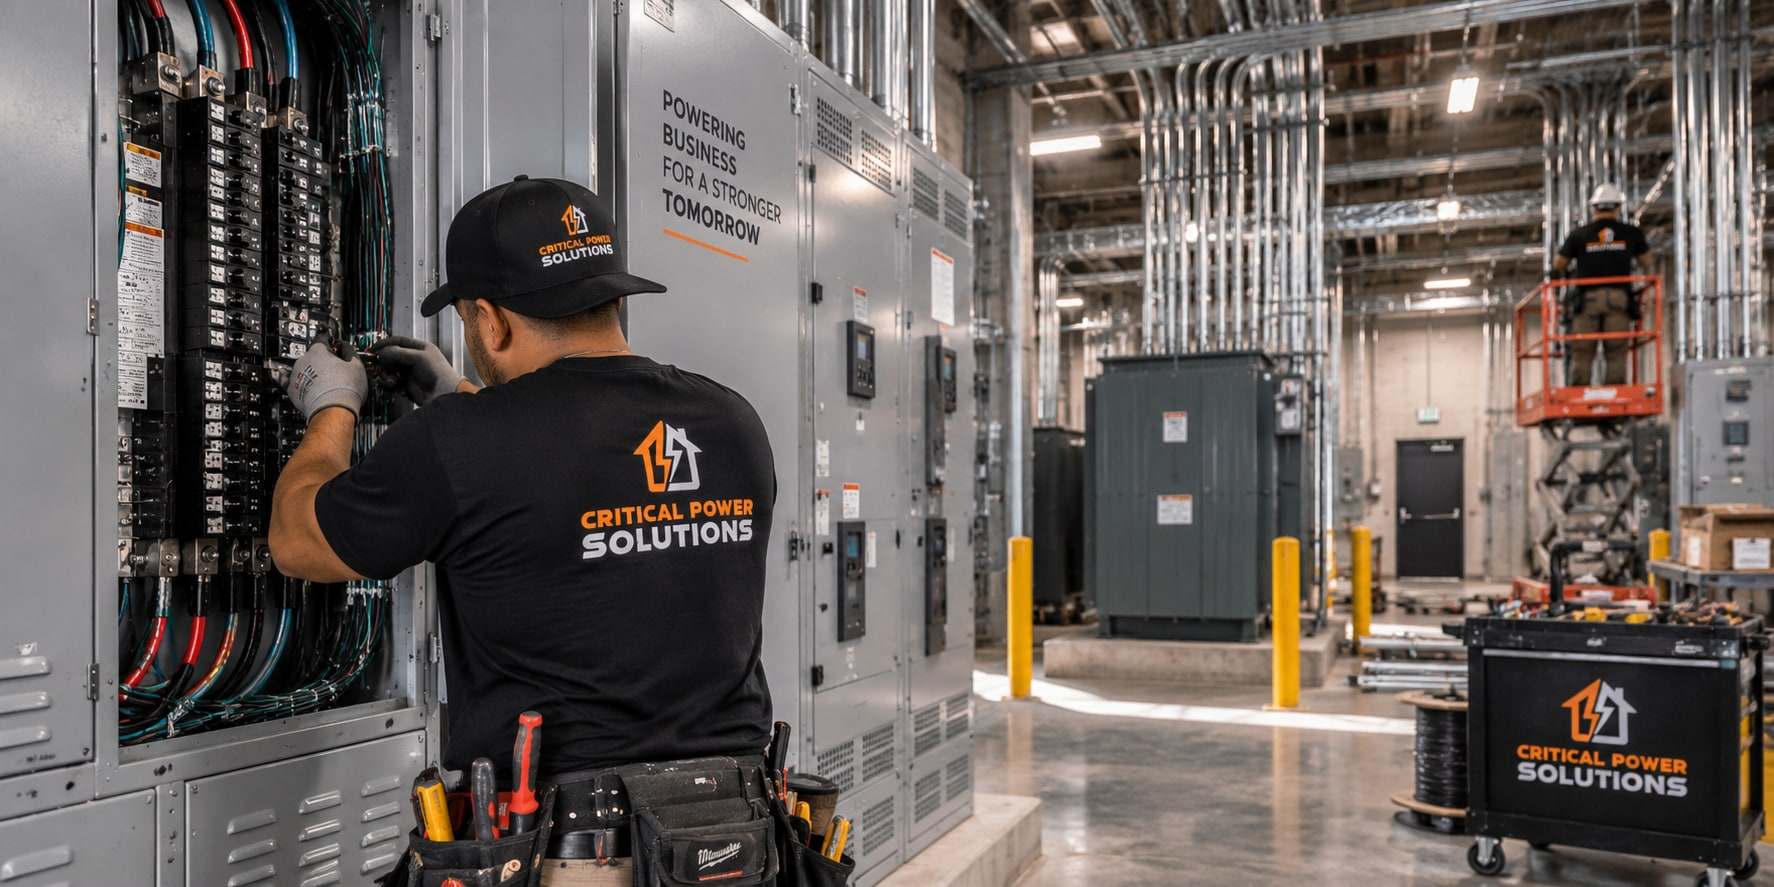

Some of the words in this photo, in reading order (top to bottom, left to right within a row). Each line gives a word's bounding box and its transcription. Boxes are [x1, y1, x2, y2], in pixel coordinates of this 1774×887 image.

[663, 89, 746, 150] POWERING
[663, 122, 737, 175] BUSINESS
[663, 155, 694, 189] FOR
[698, 172, 709, 195] A
[712, 178, 782, 225] STRONGER
[662, 188, 760, 245] TOMORROW
[539, 239, 584, 256] CRITICAL
[541, 244, 614, 268] SOLUTIONS
[580, 503, 684, 530] CRITICAL
[689, 499, 753, 519] POWER
[582, 519, 753, 560] SOLUTIONS
[1517, 744, 1606, 767] CRITICAL
[1611, 752, 1688, 775] POWER
[1517, 762, 1688, 798] SOLUTIONS
